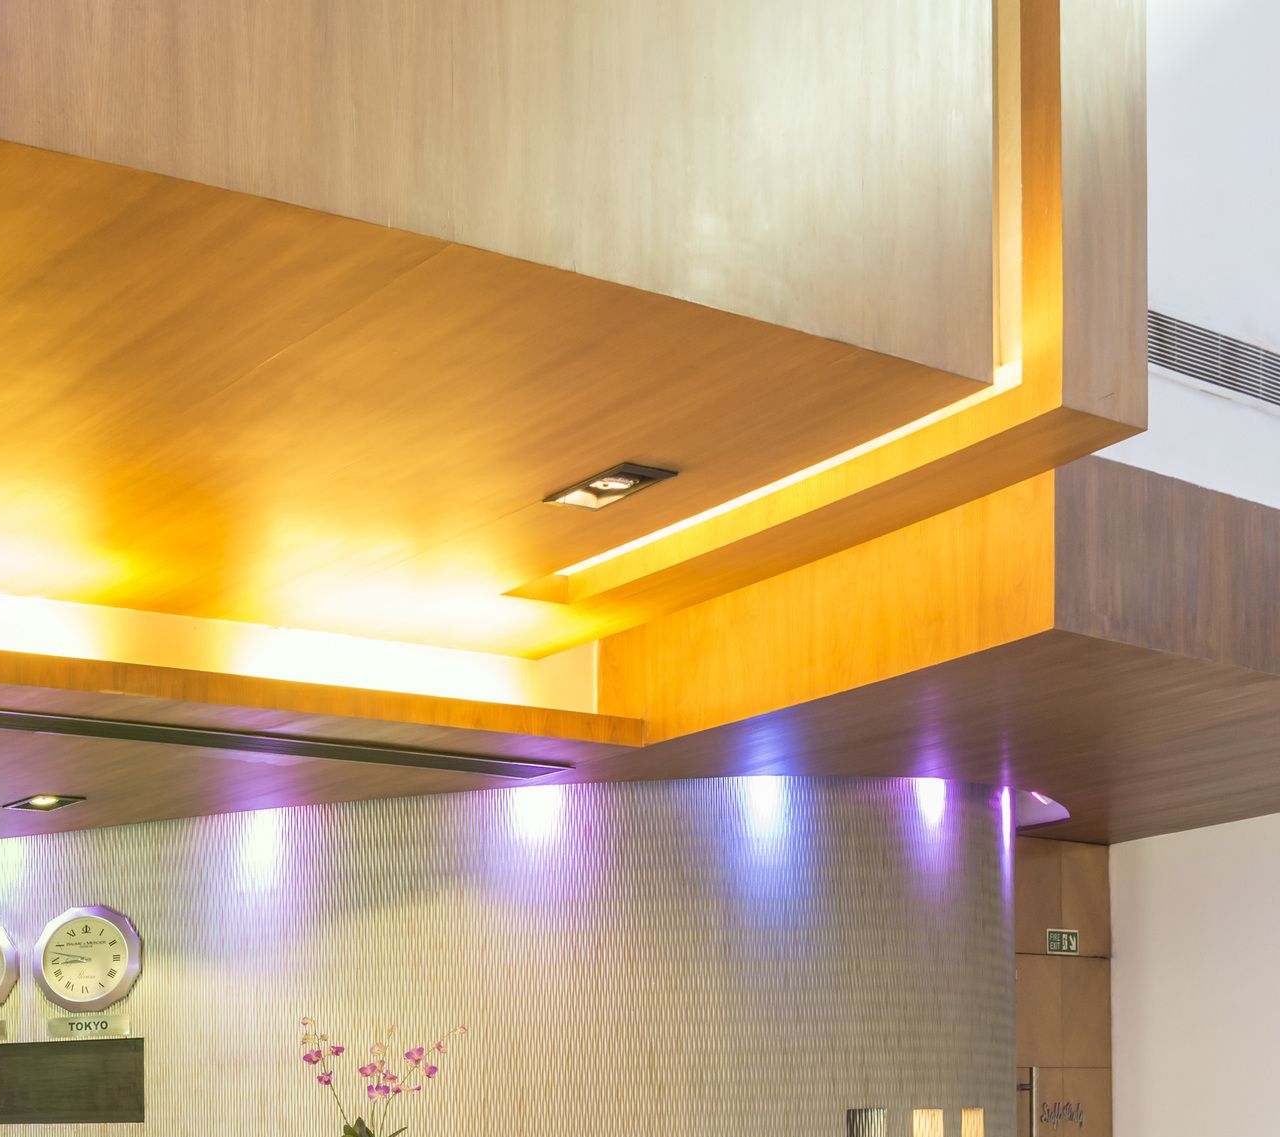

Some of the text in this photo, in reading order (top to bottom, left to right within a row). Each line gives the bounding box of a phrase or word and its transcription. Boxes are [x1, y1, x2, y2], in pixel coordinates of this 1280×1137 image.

[1050, 933, 1060, 941] FIRE
[1050, 942, 1060, 950] EXIT
[68, 1020, 109, 1032] TOKYO
